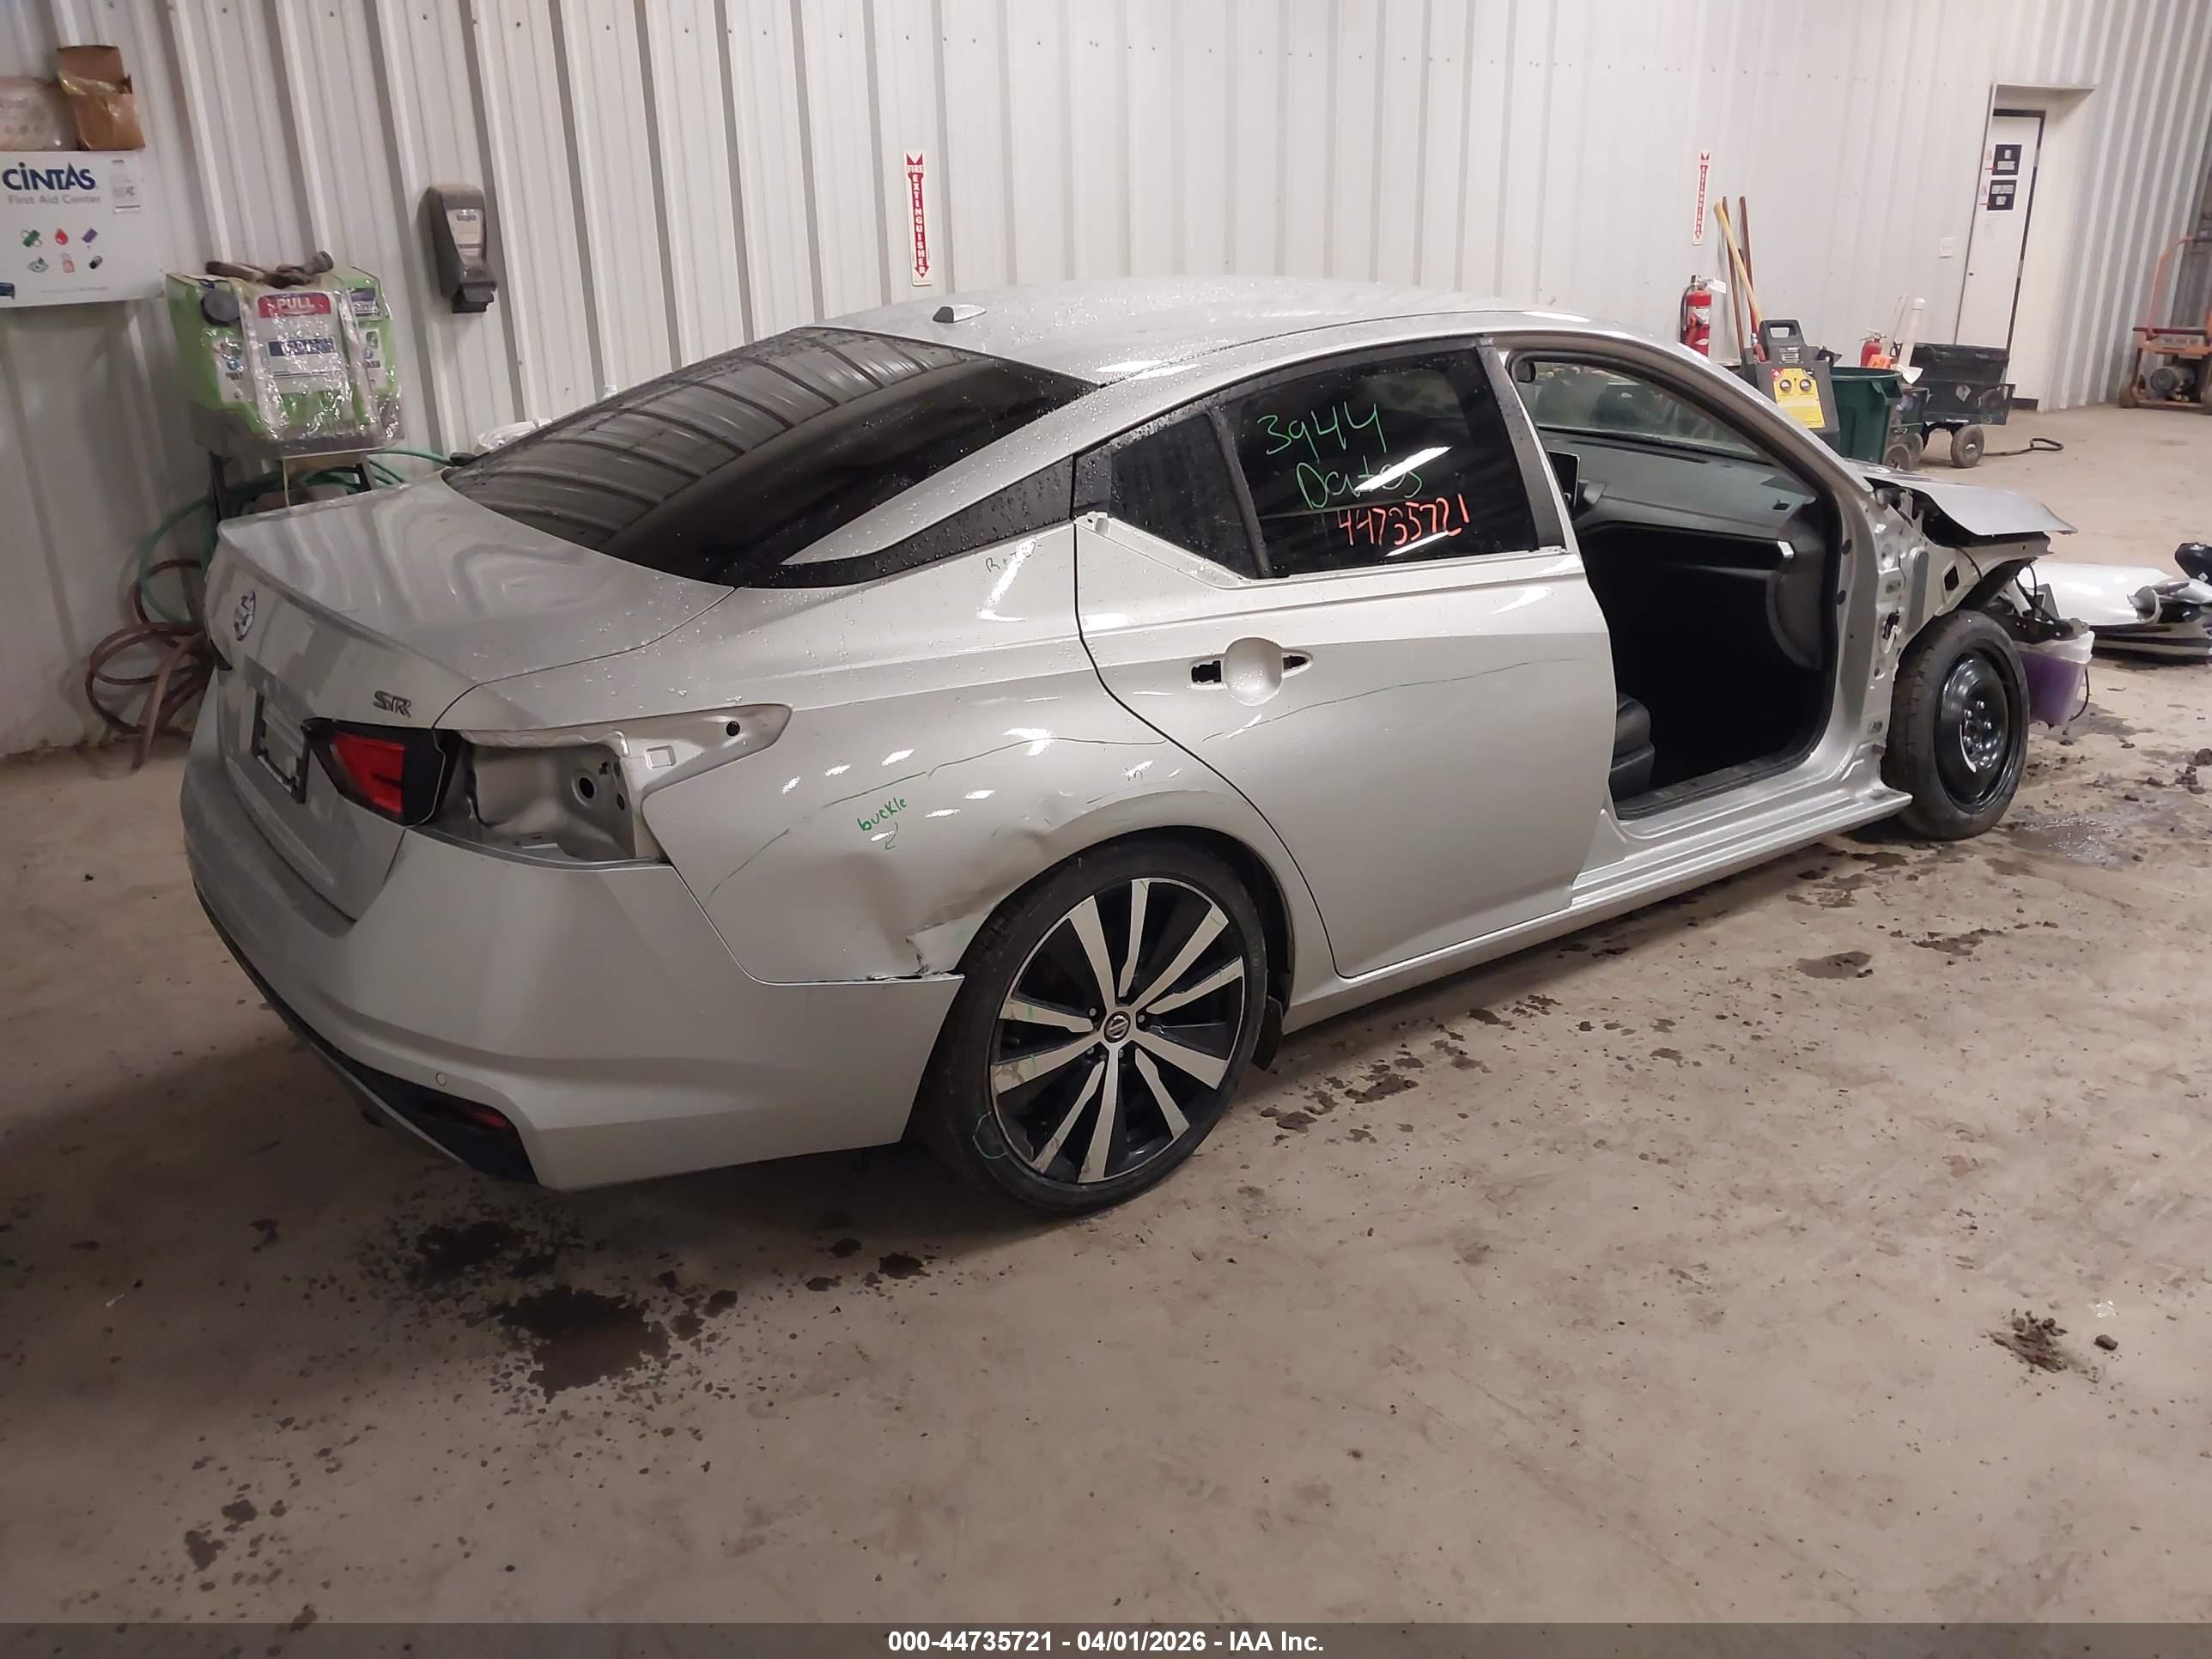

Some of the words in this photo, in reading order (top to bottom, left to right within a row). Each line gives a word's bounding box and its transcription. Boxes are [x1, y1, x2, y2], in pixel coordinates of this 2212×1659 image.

[907, 164, 924, 173] FIRE
[7, 195, 35, 204] First
[39, 195, 59, 204] Aid
[62, 195, 100, 204] Center
[912, 173, 926, 274] EXTINGUISHER
[275, 297, 315, 310] PULL
[1256, 400, 1388, 464] 3944
[1336, 493, 1470, 547] 44735721
[373, 690, 412, 719] SR
[857, 797, 908, 831] buckle
